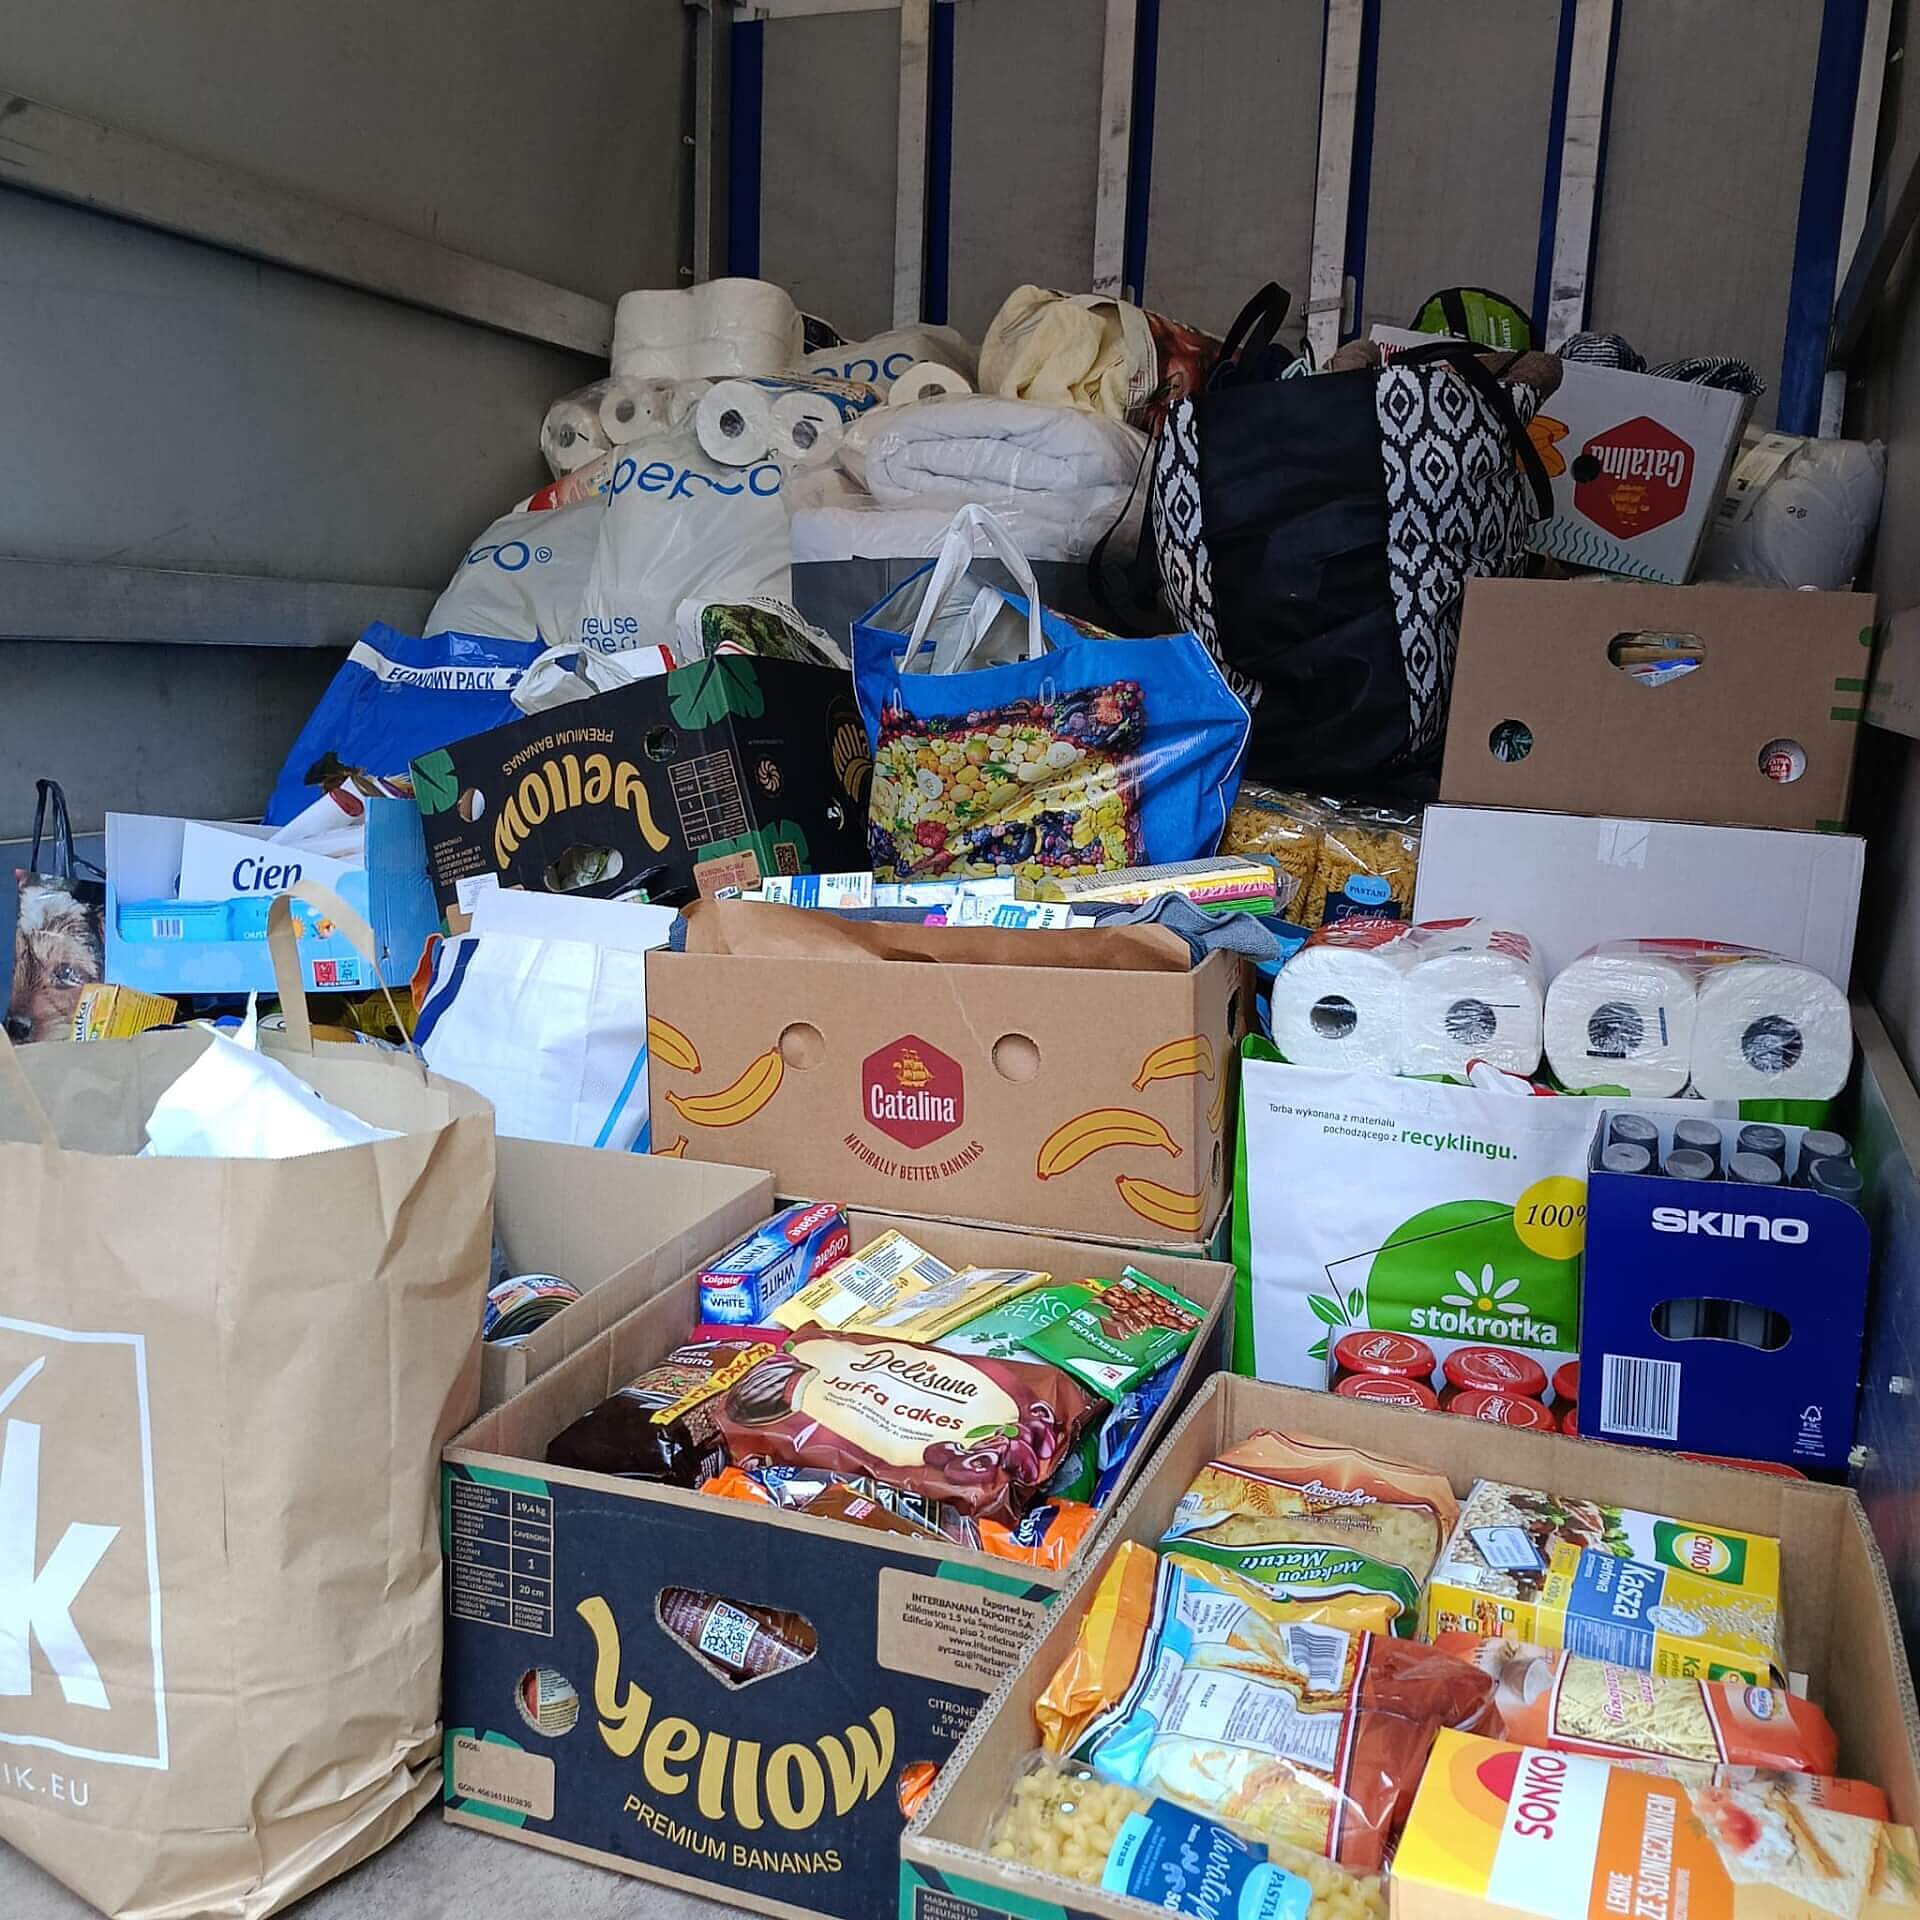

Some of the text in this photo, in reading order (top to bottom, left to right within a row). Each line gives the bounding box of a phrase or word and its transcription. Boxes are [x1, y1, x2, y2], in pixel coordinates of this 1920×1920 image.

[582, 616, 639, 635] reuse
[457, 671, 495, 690] PACK
[503, 728, 615, 776] PREMIUM BANANAS
[495, 753, 671, 870] yellow
[232, 856, 303, 891] Cien
[870, 1083, 956, 1123] Catalina
[1269, 1103, 1293, 1115] Torba
[1295, 1107, 1340, 1121] wykonana
[843, 1132, 985, 1181] NATURALLY BETTER BANANAS
[1323, 1124, 1390, 1142] pochodzącego
[1400, 1128, 1518, 1160] recyklingu.
[787, 1203, 838, 1237] Colgate
[815, 1234, 849, 1268] Colgate
[701, 1275, 741, 1287] Colgate
[760, 1263, 796, 1301] WHITE
[709, 1298, 746, 1309] WHITE
[1409, 1306, 1559, 1345] stokrotka
[849, 1349, 979, 1399] Delisana
[822, 1376, 964, 1431] Jaffa cakes
[527, 1558, 535, 1570] 1
[1691, 1534, 1713, 1573] CENOS
[1276, 1560, 1365, 1584] Makaron
[519, 1584, 545, 1598] 20 cm
[911, 1592, 980, 1616] INTERBANANA
[981, 1608, 1016, 1625] EXPORT
[1611, 1562, 1656, 1620] Kasza
[902, 1613, 933, 1628] Edificio
[576, 1596, 896, 1830] yellow
[1513, 1755, 1568, 1841] SONKO
[623, 1793, 842, 1875] PREMIUM BANANAS
[923, 1893, 979, 1917] MASA NETTO
[1258, 1870, 1286, 1920] PASTA
